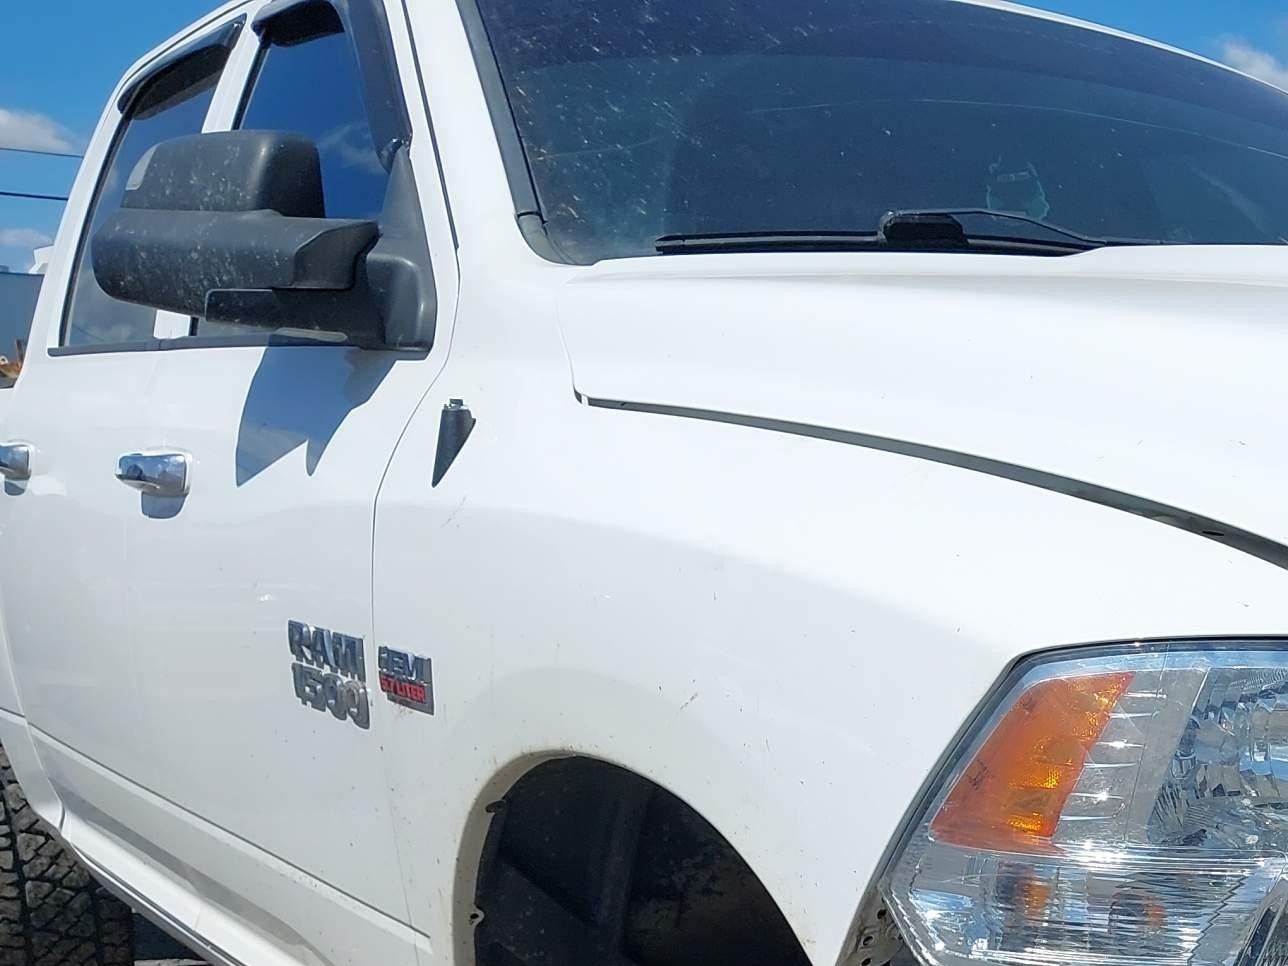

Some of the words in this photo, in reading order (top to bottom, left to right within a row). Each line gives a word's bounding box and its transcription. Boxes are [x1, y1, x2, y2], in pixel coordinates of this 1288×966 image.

[288, 620, 366, 684] RAM
[292, 663, 370, 729] 1500
[396, 679, 426, 704] LITER
